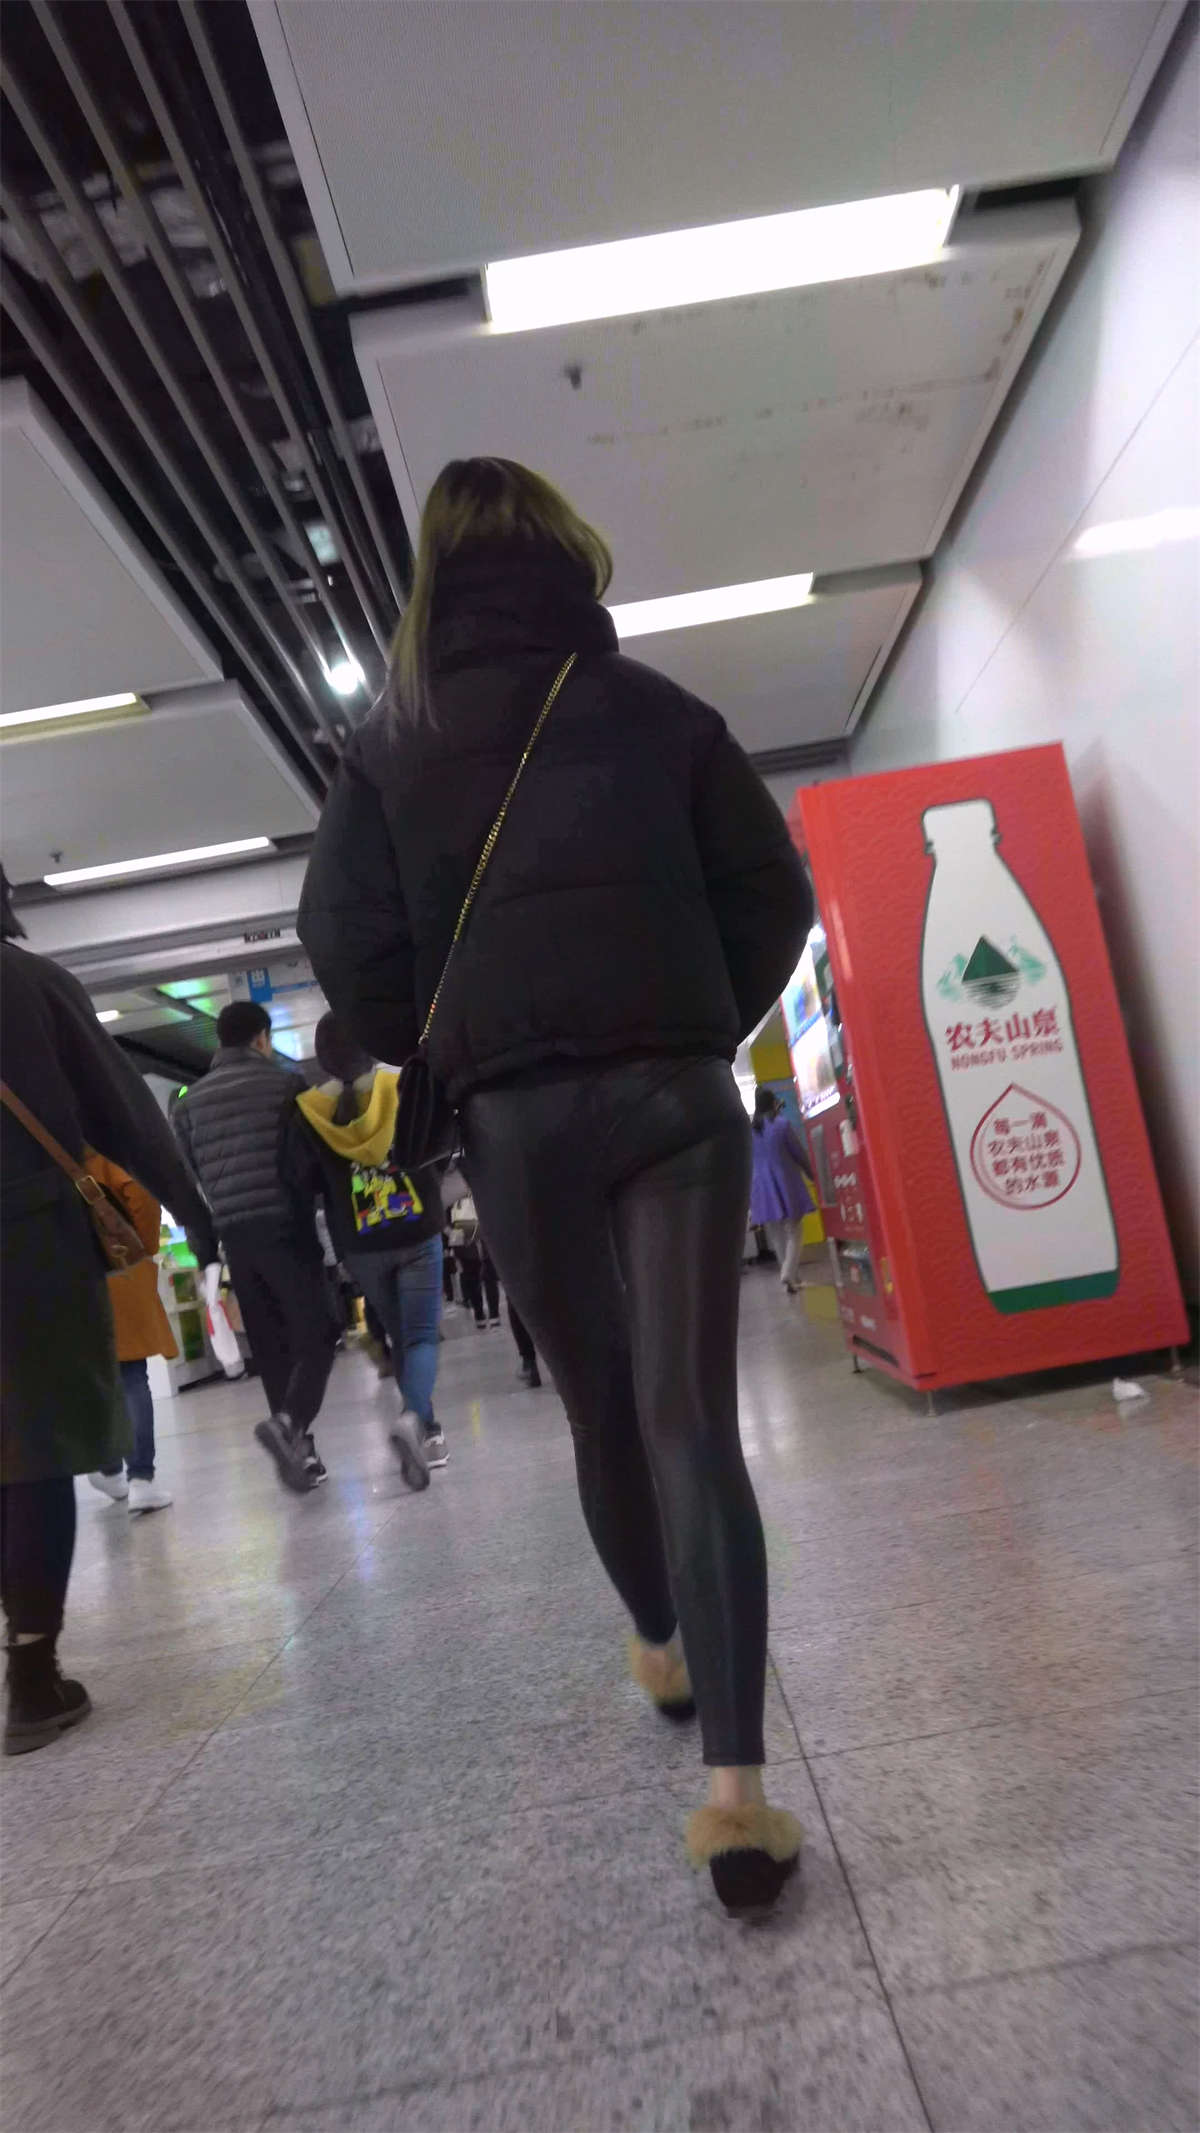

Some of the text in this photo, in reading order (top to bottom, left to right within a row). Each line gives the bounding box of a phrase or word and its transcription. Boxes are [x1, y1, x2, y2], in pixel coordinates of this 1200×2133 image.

[945, 1005, 1060, 1051] 农夫山泉
[951, 1038, 1064, 1071] NONGFU SPRING
